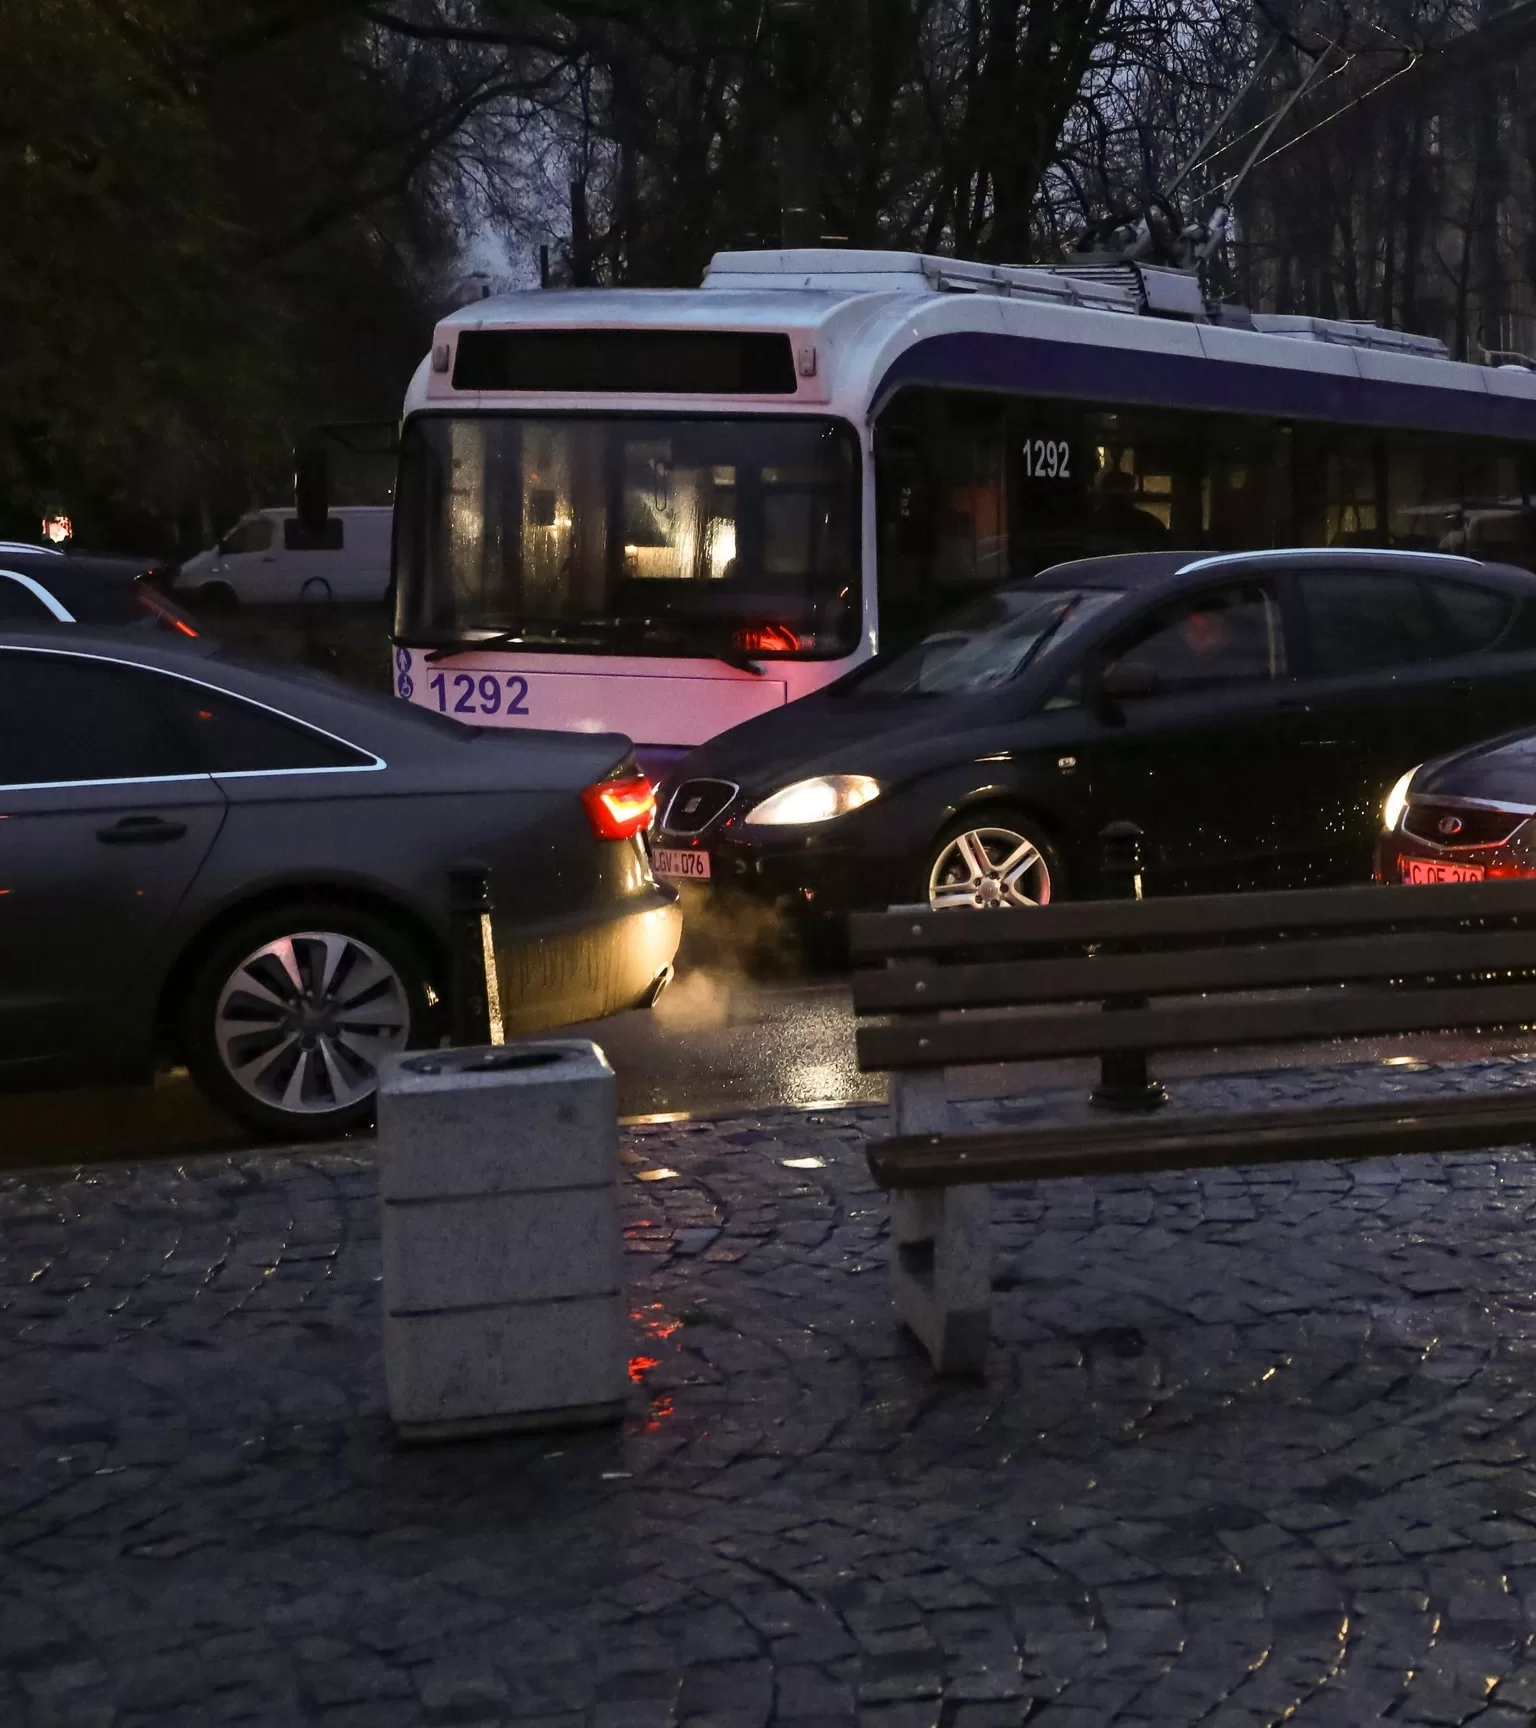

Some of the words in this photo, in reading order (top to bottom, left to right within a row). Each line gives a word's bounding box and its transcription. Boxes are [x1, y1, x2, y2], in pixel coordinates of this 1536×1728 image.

[1022, 438, 1071, 479] 1292
[430, 673, 529, 715] 1292
[681, 853, 704, 875] 076
